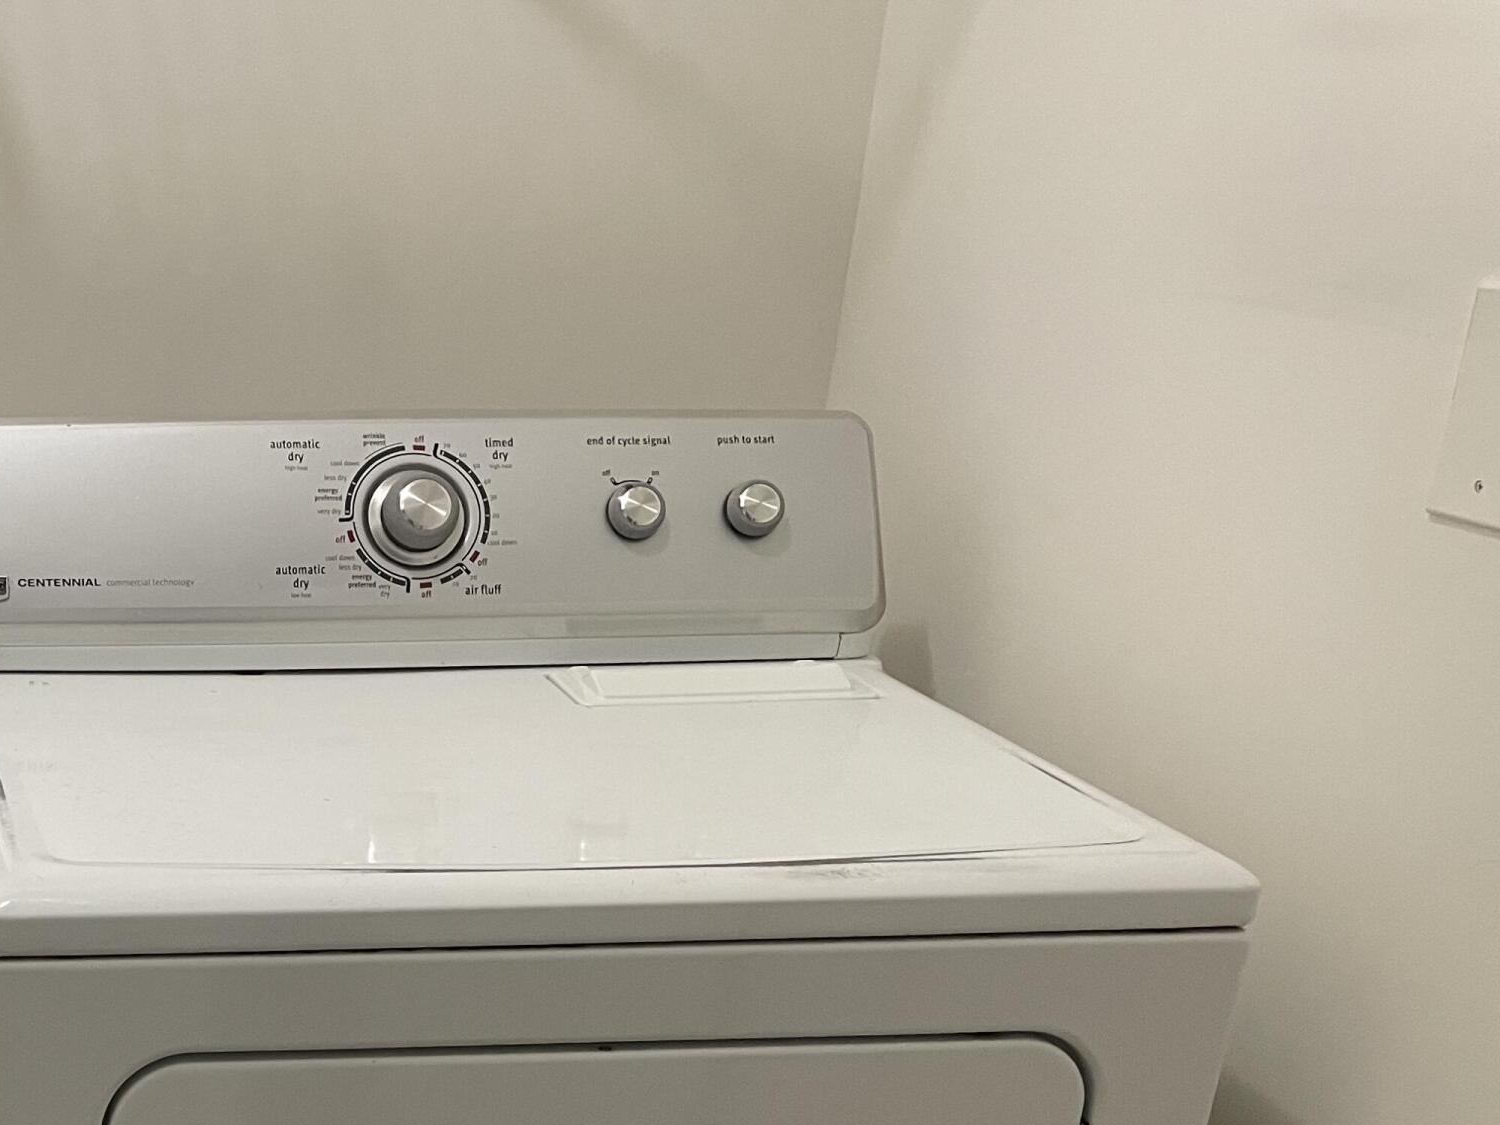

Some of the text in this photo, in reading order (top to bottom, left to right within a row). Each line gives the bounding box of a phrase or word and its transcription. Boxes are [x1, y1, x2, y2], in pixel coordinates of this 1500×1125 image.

[269, 438, 321, 449] automatic
[362, 439, 386, 447] prevent
[414, 435, 425, 443] off
[484, 436, 515, 448] timed
[586, 435, 672, 447] end of cycle signal
[716, 435, 776, 446] push to start
[287, 451, 305, 463] dry
[491, 449, 509, 462] dry
[337, 474, 348, 482] dry
[314, 494, 343, 502] preferred
[335, 535, 346, 544] off
[477, 558, 489, 567] off
[275, 563, 327, 576] automatic
[351, 563, 363, 572] dry
[17, 578, 195, 588] CENTENNIAL commercial technology
[292, 577, 310, 591] dry
[347, 581, 377, 589] preferred
[464, 583, 502, 596] air fluff
[379, 590, 391, 599] dry
[420, 590, 432, 599] off
